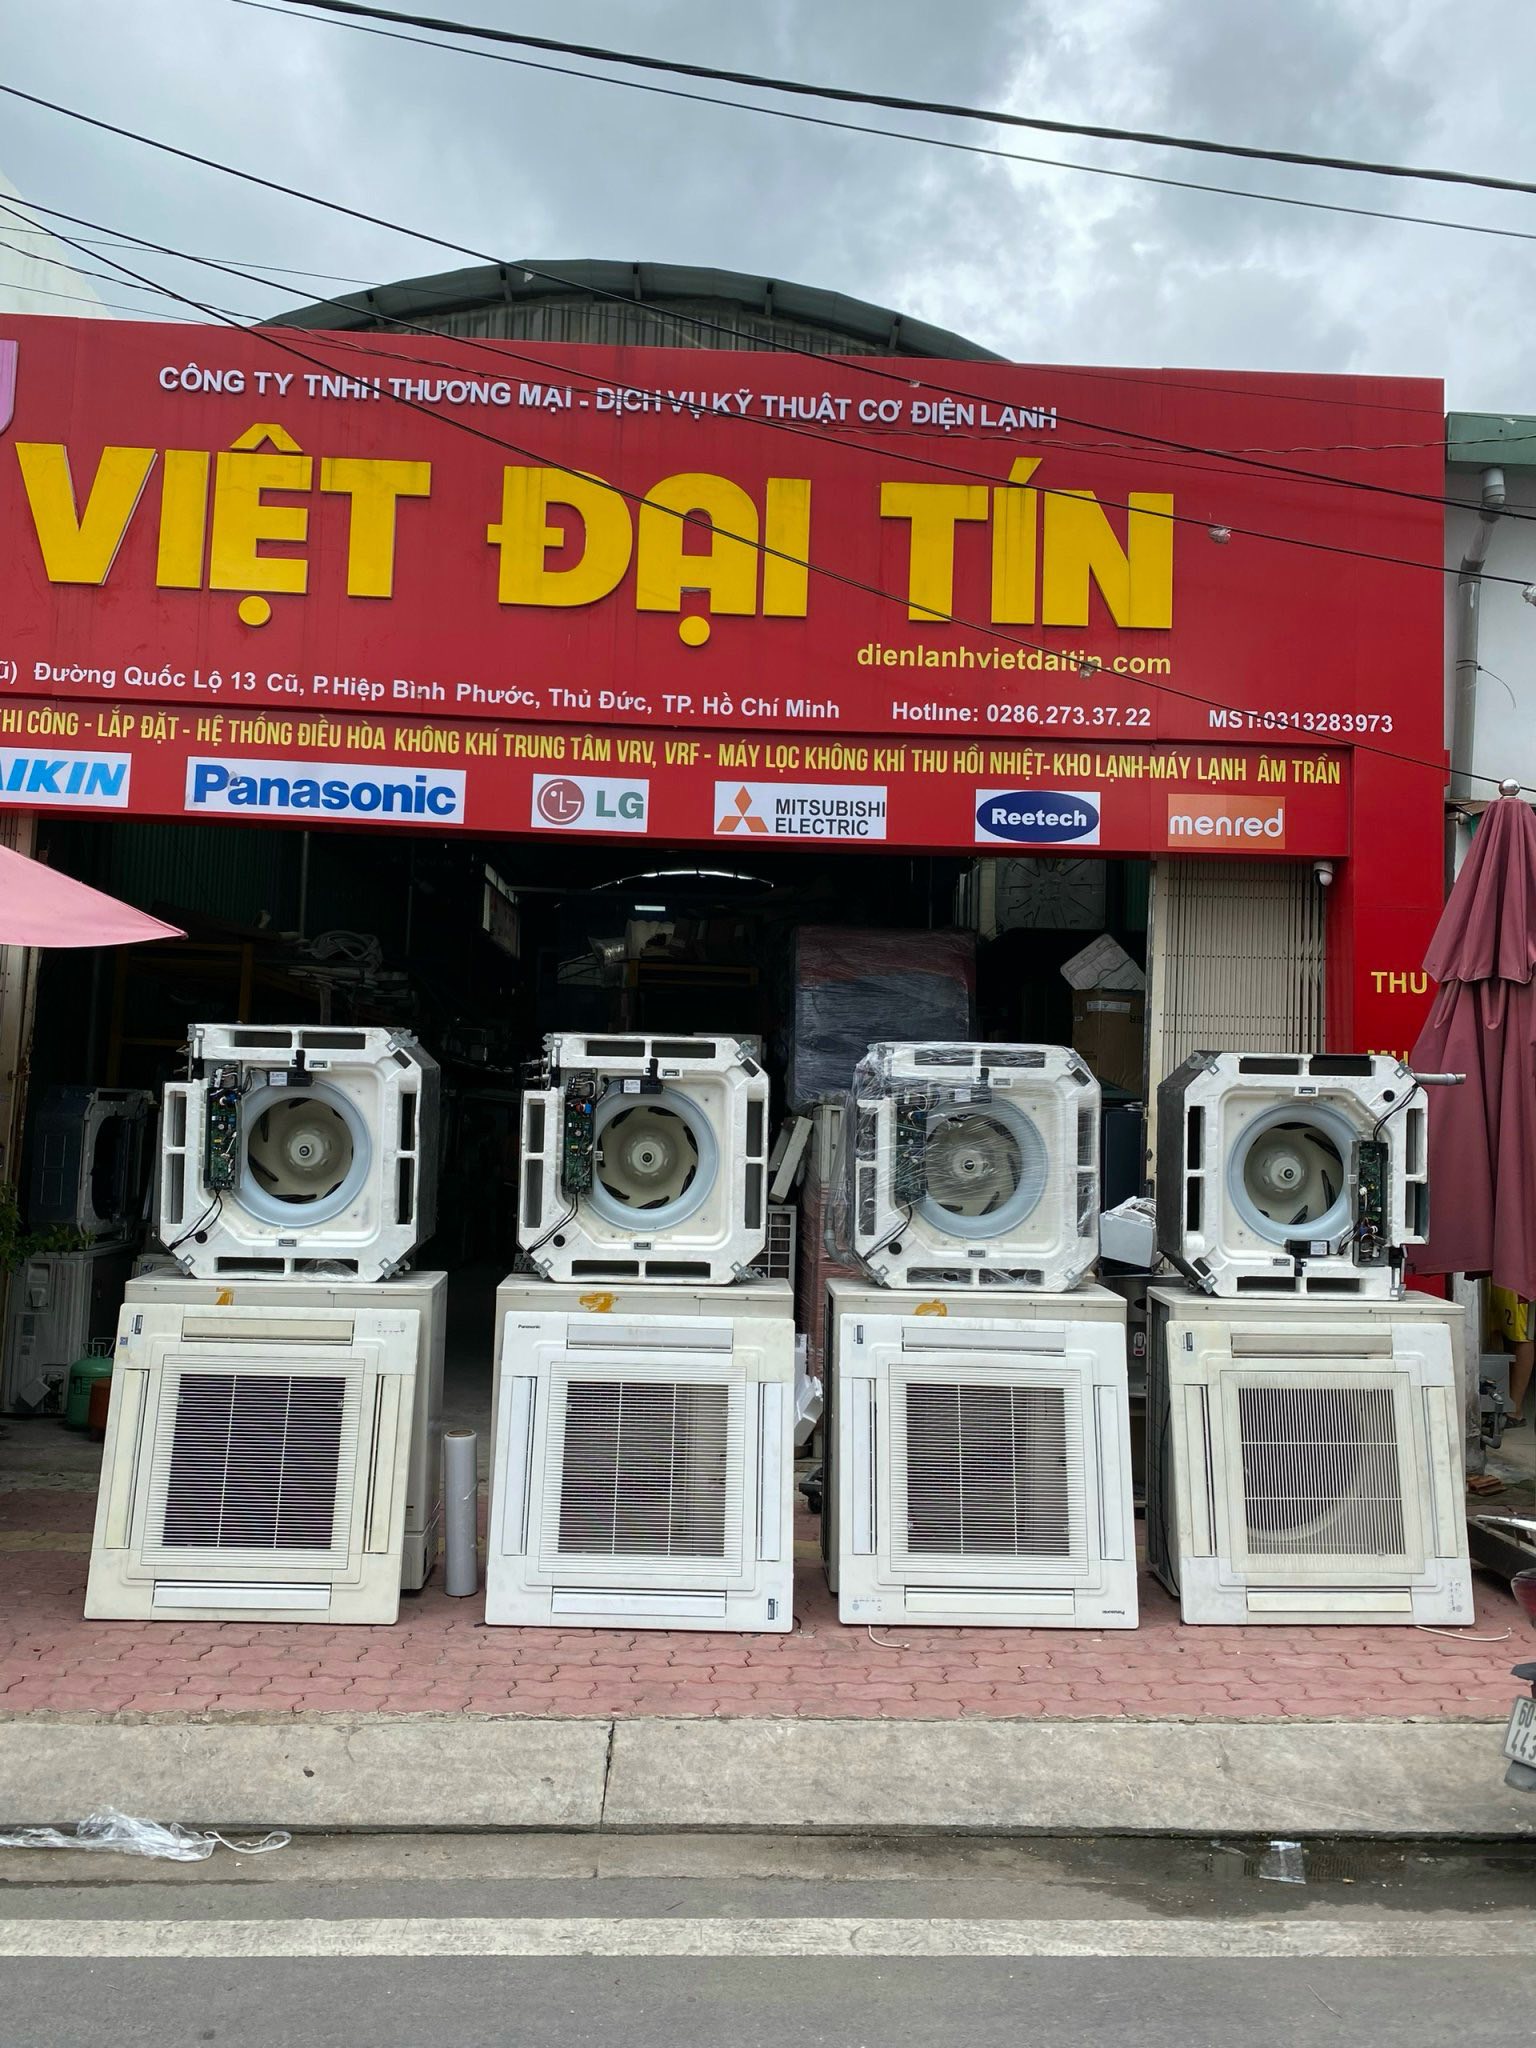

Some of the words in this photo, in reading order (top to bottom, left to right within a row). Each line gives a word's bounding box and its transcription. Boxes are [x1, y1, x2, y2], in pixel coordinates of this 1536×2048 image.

[159, 362, 245, 394] CÔNG
[254, 371, 294, 395] TY
[304, 374, 381, 399] TNHH
[388, 376, 511, 405] THƯƠNG
[518, 383, 571, 414] MẠI
[596, 386, 661, 416] DỊCH
[667, 390, 706, 420] VỤ
[712, 388, 754, 416] KỸ
[760, 392, 851, 424] THUẬT
[858, 398, 902, 422] CƠ
[910, 397, 974, 430] ĐIỆN
[980, 404, 1057, 432] LẠNH
[15, 423, 431, 627] VIỆT
[487, 465, 811, 646] ĐẠI
[880, 457, 1174, 629] TÍN
[857, 644, 1171, 675] dienlanhvietdaitin.com
[34, 661, 116, 689] Đường
[124, 663, 186, 688] Quốc
[194, 669, 222, 694] Lộ
[230, 672, 256, 690] 13
[267, 673, 304, 697] Cũ,
[392, 680, 445, 701] Bình
[456, 683, 541, 709] Phước,
[549, 688, 591, 708] Thủ
[599, 690, 652, 714] Đức,
[662, 694, 695, 714] TP.
[703, 692, 733, 716] Hồ
[741, 697, 777, 717] Chí
[785, 699, 839, 719] Minh
[892, 702, 978, 722] Hotline:
[986, 703, 1151, 727] 0286.273.37.22
[0, 708, 22, 732] HI
[27, 706, 78, 736] CÔNG
[97, 705, 135, 739] LẮP
[141, 712, 179, 744] ĐẶT
[197, 714, 223, 746] HỆ
[228, 711, 292, 746] THỐNG
[298, 714, 341, 748] ĐIỀU
[347, 720, 385, 750] HÒA
[394, 725, 460, 754] KHÔNG
[466, 728, 500, 756] KHÍ
[503, 733, 565, 760] TRUNG
[571, 734, 611, 762] TÂM
[616, 739, 657, 768] VRV,
[665, 742, 700, 765] VRF
[719, 739, 760, 768] MÁY
[765, 744, 799, 773] LỌC
[805, 743, 867, 771] KHÔNG
[873, 744, 907, 772] KHÍ
[911, 749, 948, 773] THU
[953, 743, 983, 774] HỒI
[1197, 756, 1246, 785] LẠNH
[1257, 754, 1286, 783] ÂM
[1292, 752, 1340, 784] TRẦN
[0, 758, 127, 796] IKIN
[193, 764, 456, 816] Panasonic
[596, 790, 644, 819] LG
[776, 799, 886, 818] MITSUBISHI
[991, 808, 1087, 827] Reetech
[776, 818, 869, 836] ELECTRIC
[1169, 808, 1283, 838] menred
[1371, 971, 1428, 994] THU
